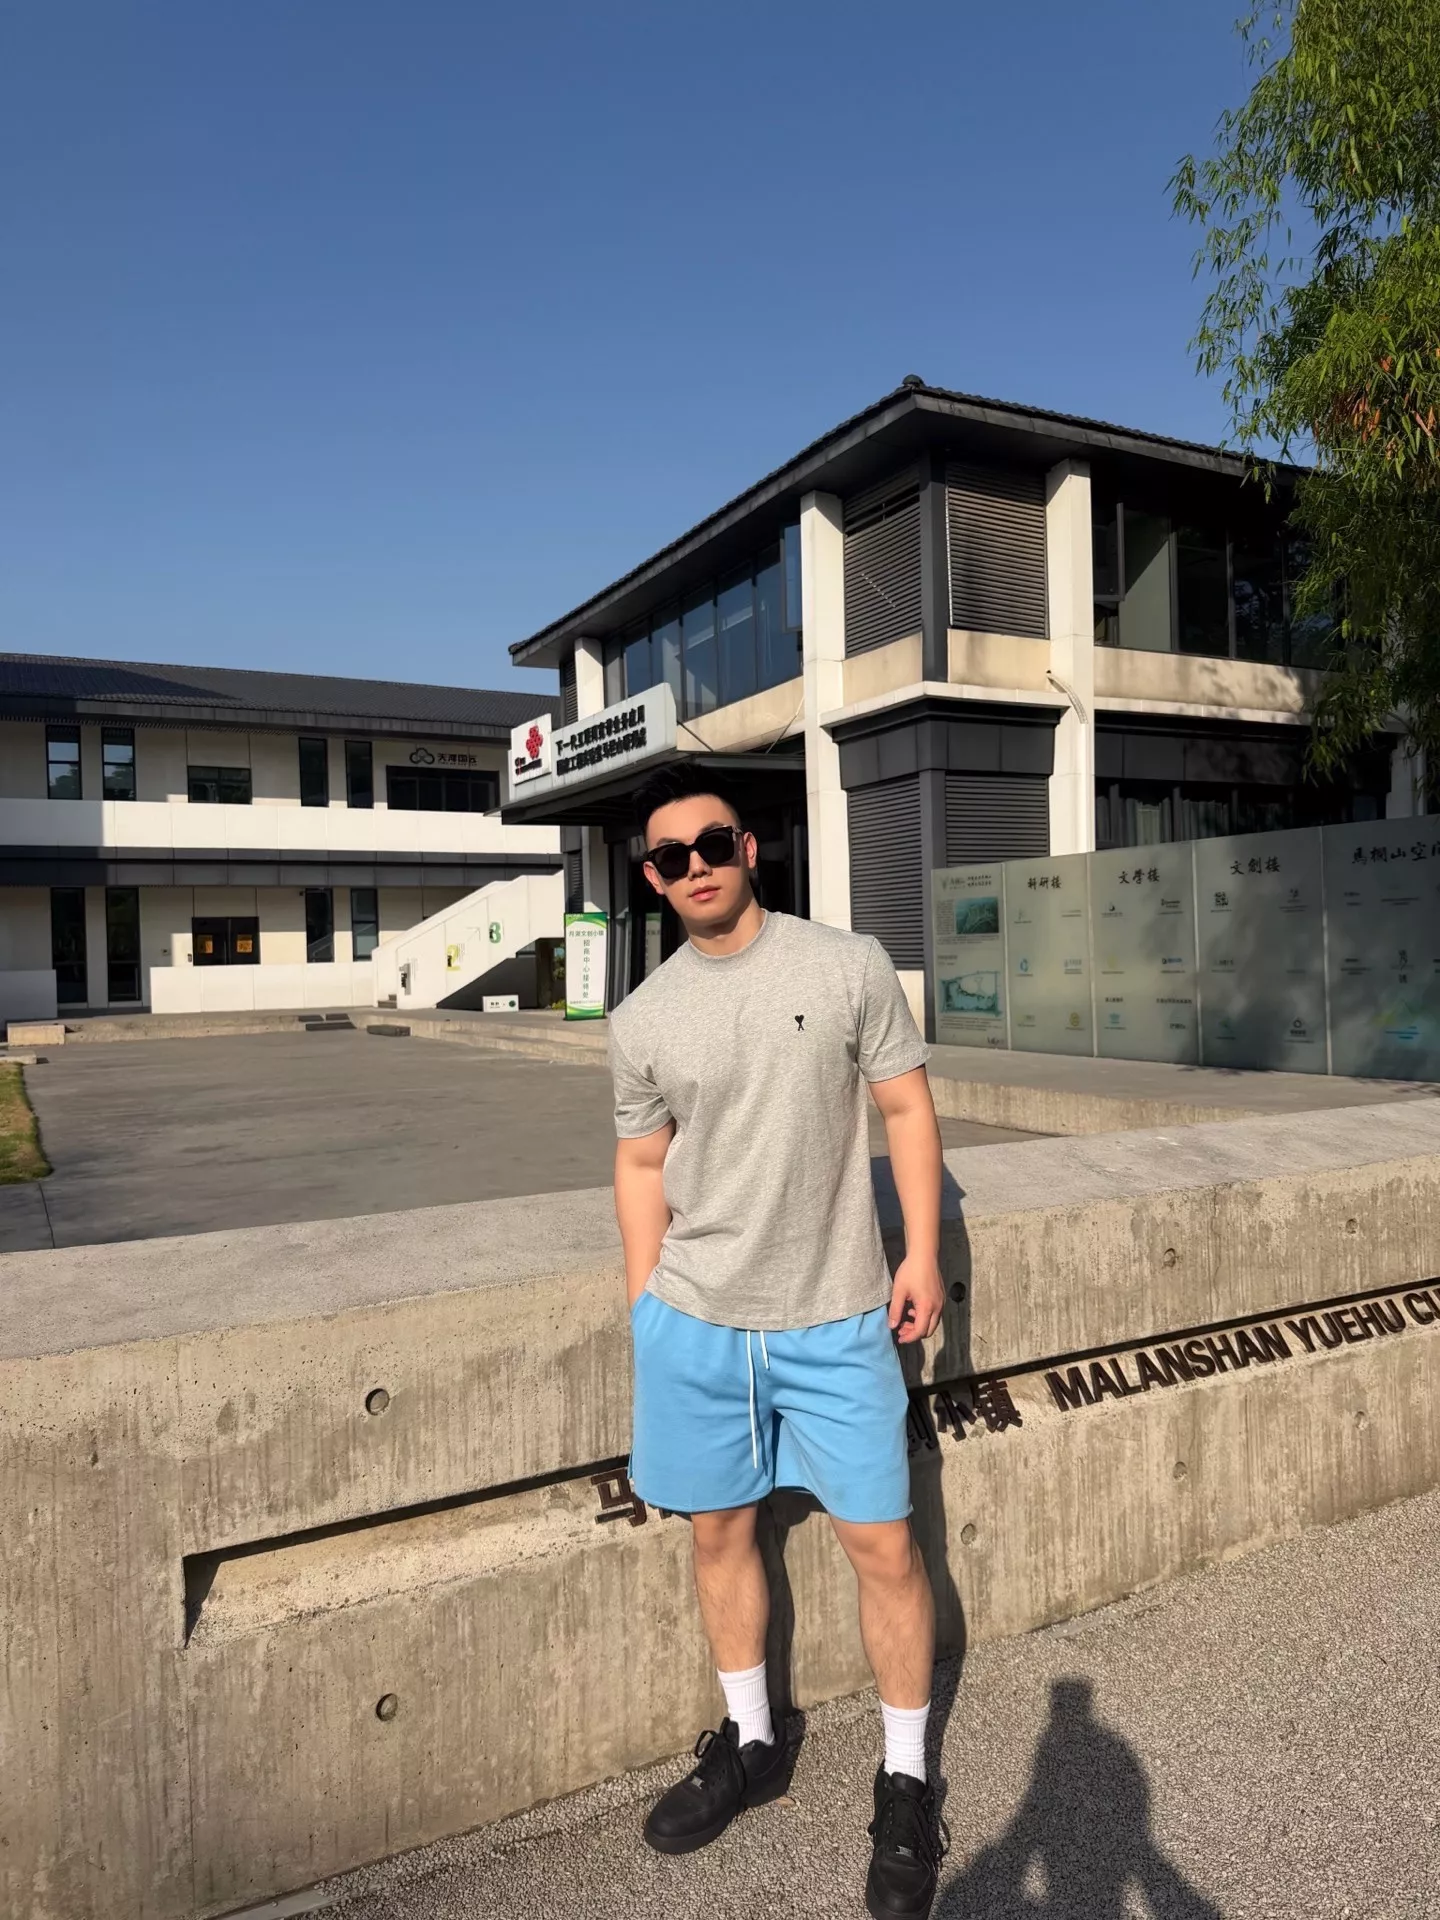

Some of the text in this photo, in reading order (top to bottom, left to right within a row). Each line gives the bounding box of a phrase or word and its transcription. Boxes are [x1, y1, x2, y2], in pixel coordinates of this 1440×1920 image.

[489, 922, 501, 943] 3
[1044, 1323, 1293, 1412] MALANSHAN
[1284, 1298, 1407, 1353] YUEHU
